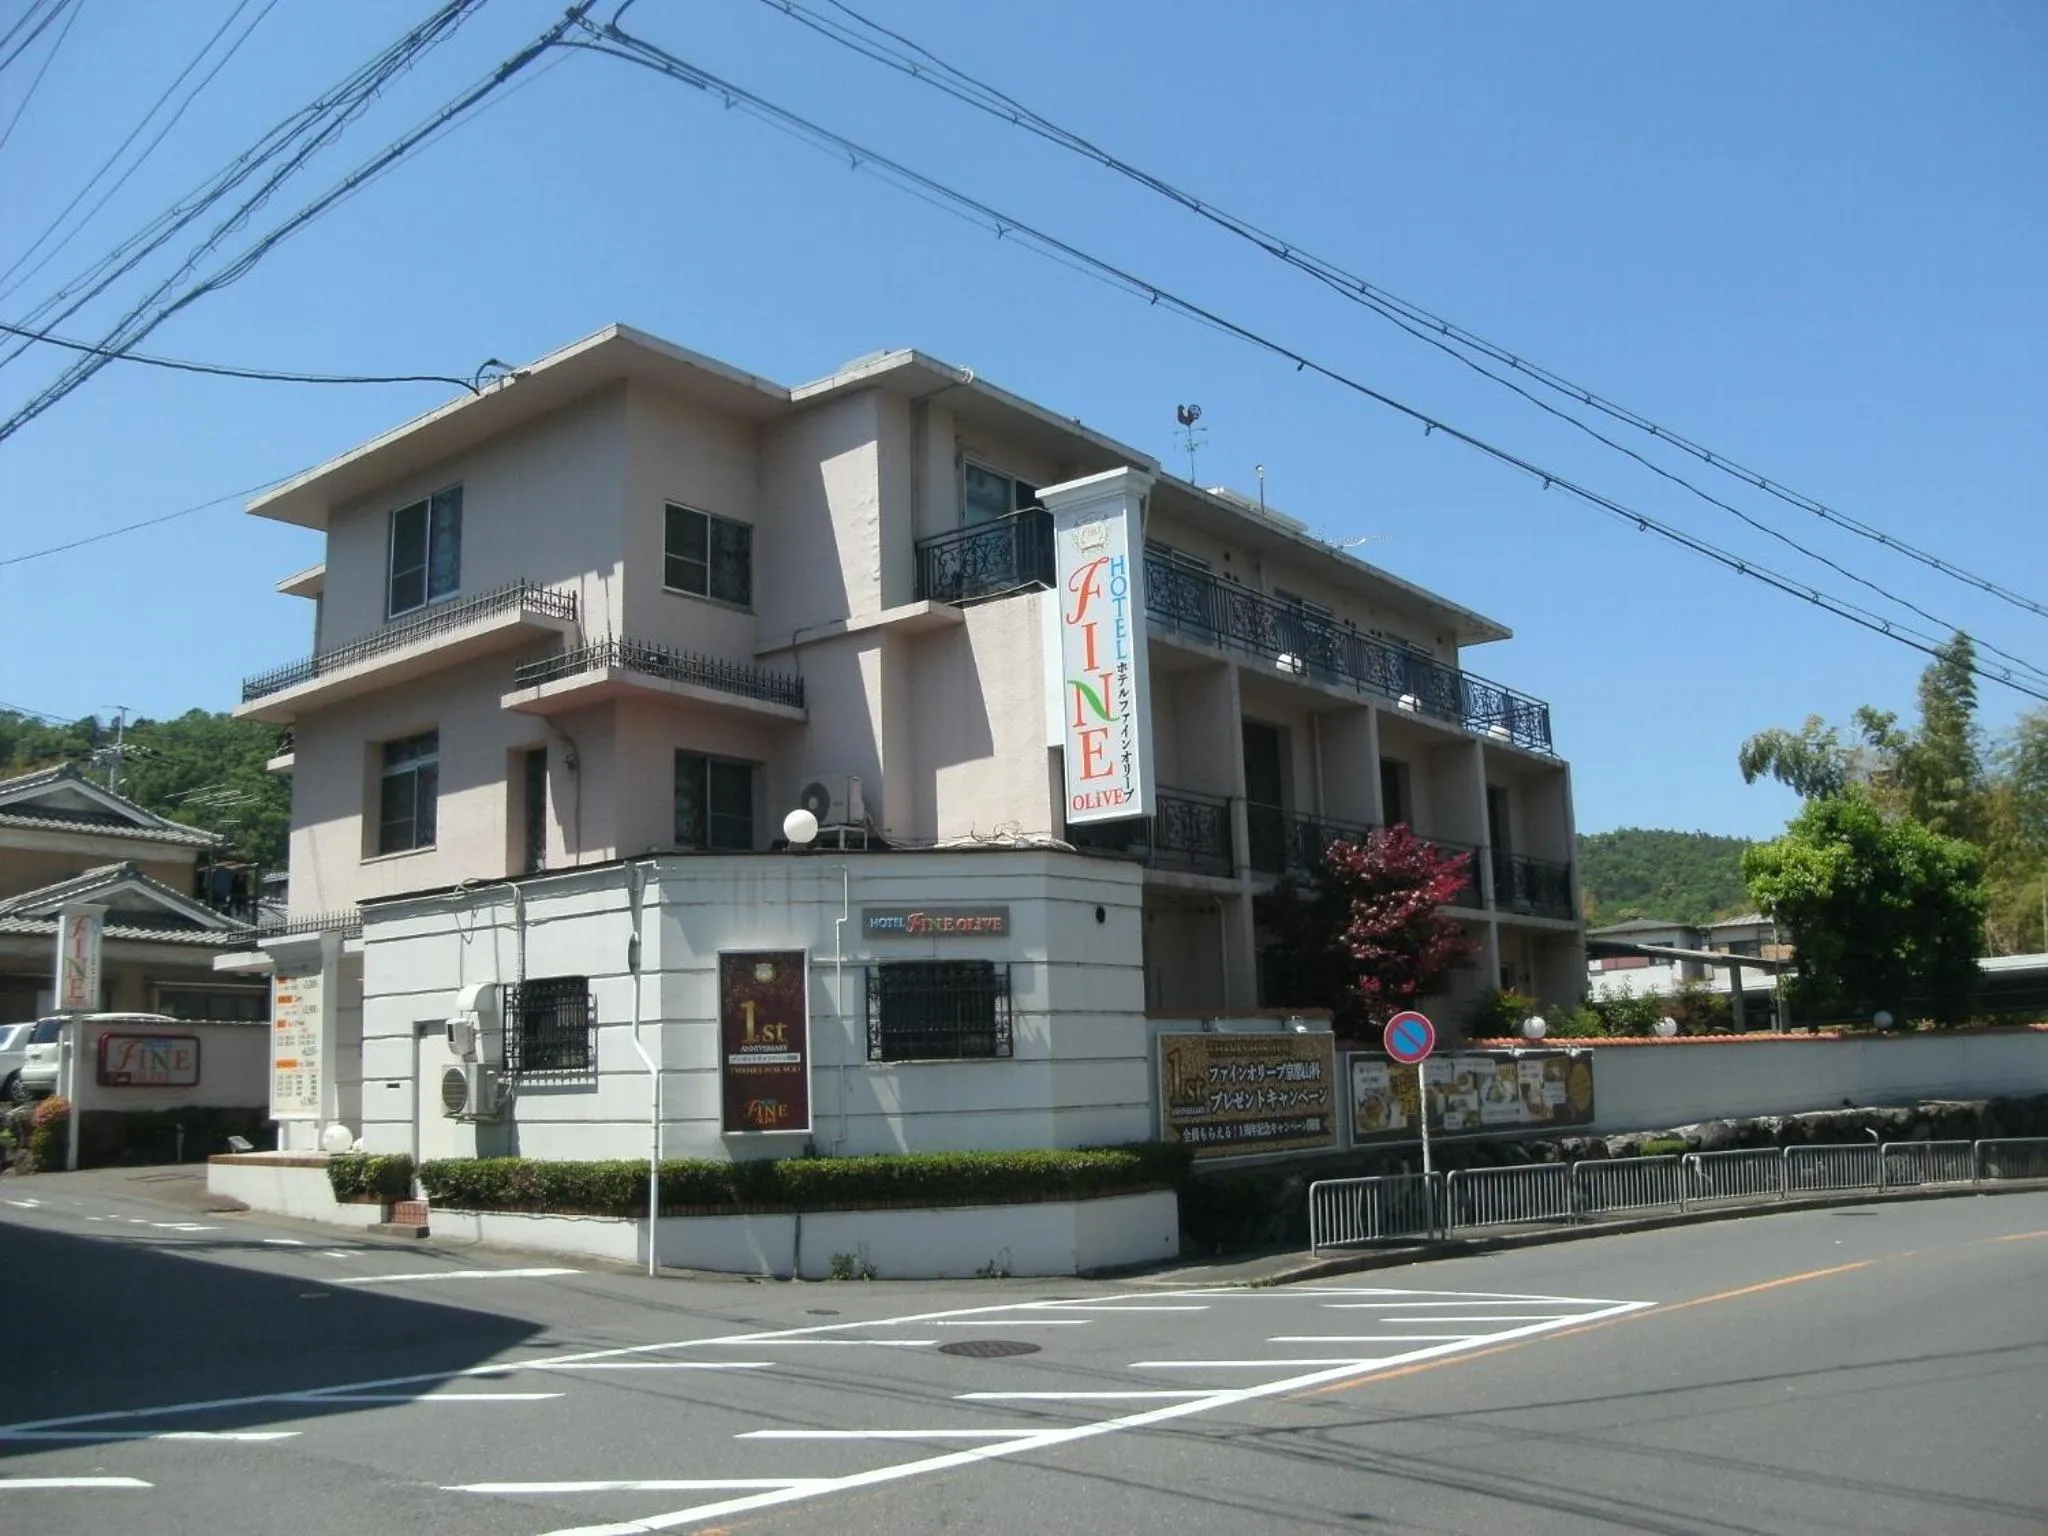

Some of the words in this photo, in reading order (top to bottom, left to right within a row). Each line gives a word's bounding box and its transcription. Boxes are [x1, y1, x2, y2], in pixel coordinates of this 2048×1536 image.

[1066, 556, 1121, 780] FINE
[1110, 555, 1128, 660] HOTEL
[1116, 662, 1134, 803] ホテルファインオリーブ
[869, 916, 905, 929] HOTEL
